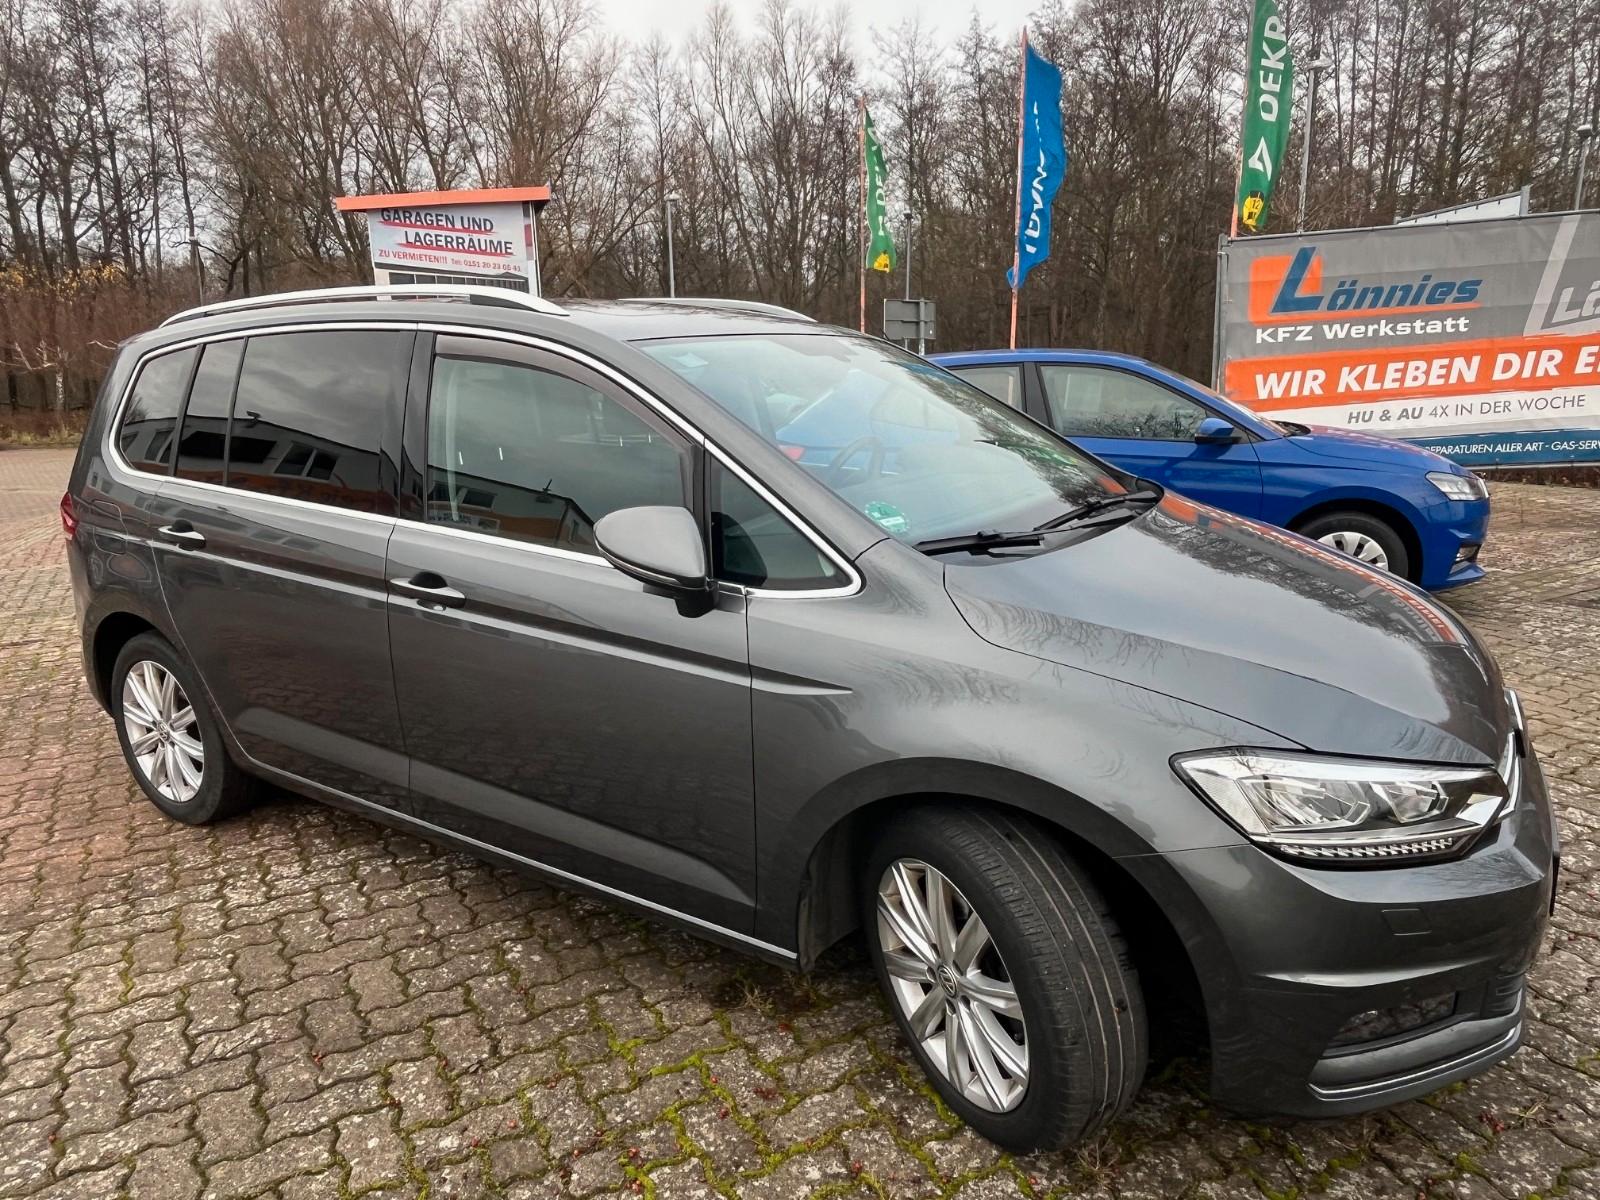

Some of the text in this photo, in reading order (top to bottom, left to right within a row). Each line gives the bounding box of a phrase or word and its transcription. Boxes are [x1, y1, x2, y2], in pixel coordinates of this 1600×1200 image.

[381, 208, 494, 232] GARAGEN UND
[405, 230, 513, 254] LAGERRÄUME
[379, 249, 390, 257] ZU
[392, 250, 447, 264] VERMIETEN!!!
[1256, 316, 1470, 344] KFZ Werkstatt
[1255, 345, 1600, 400] WIR KLEBEN DIR E
[1347, 394, 1586, 424] HU & AU 4X IN DER WOCHE
[1495, 443, 1522, 453] ALLER
[1524, 442, 1544, 452] ART
